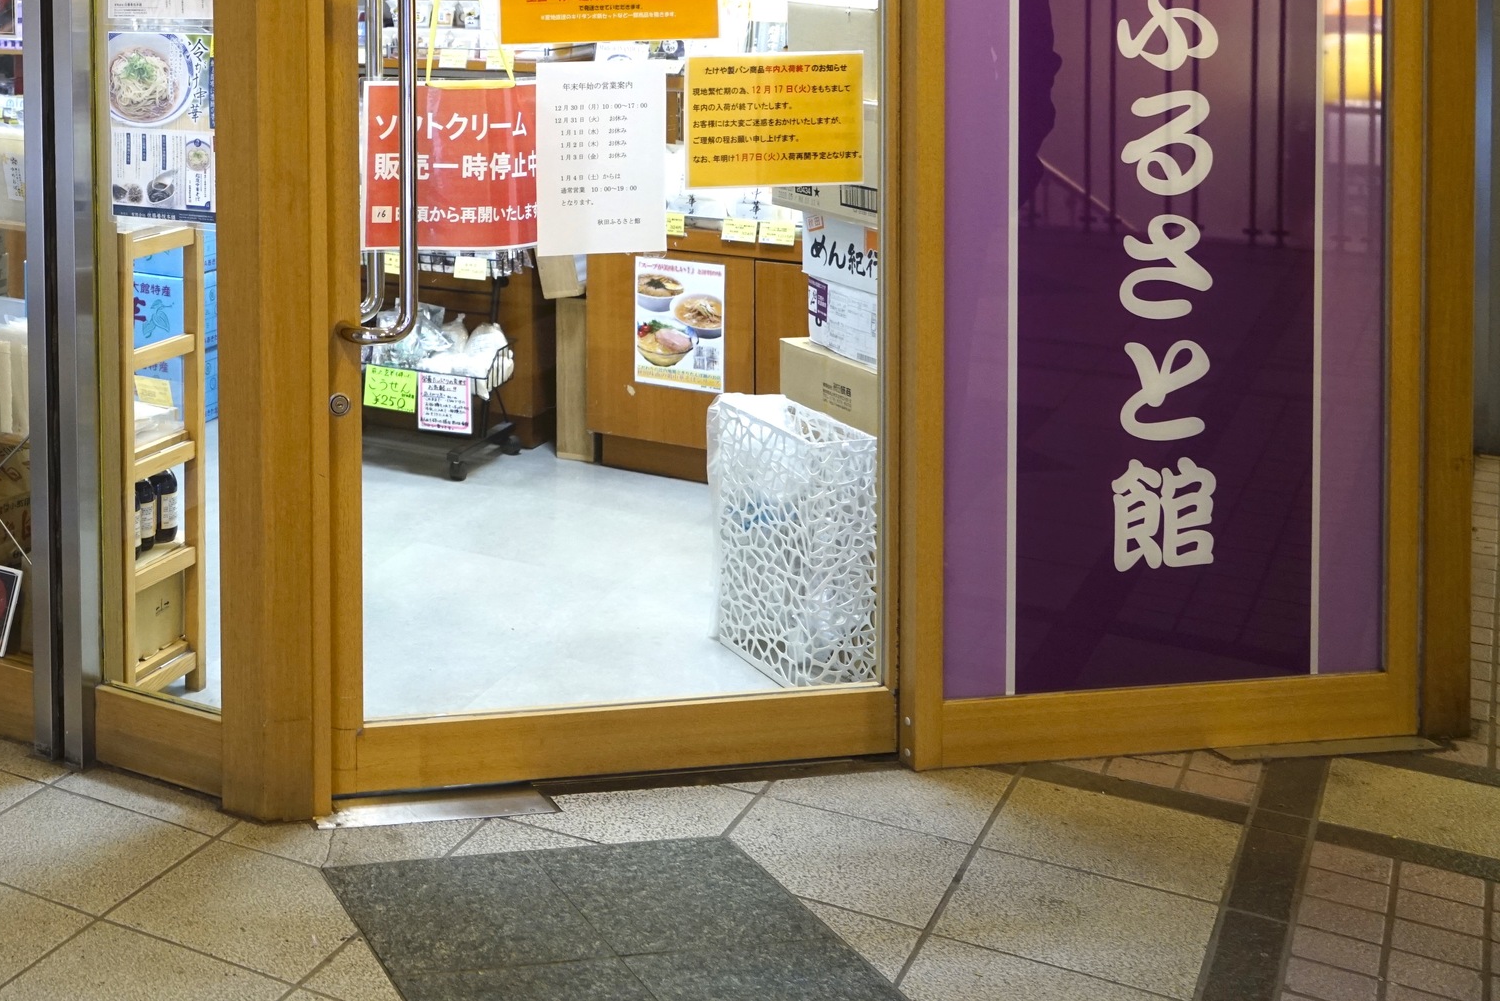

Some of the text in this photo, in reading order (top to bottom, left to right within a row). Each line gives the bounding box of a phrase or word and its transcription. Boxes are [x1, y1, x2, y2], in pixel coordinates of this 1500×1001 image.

[562, 81, 633, 91] 年末年始の営業案内
[608, 127, 627, 135] お休み
[608, 152, 627, 160] お休み
[560, 186, 585, 195] 通常営業
[597, 217, 641, 226] 秋田ふるさと館
